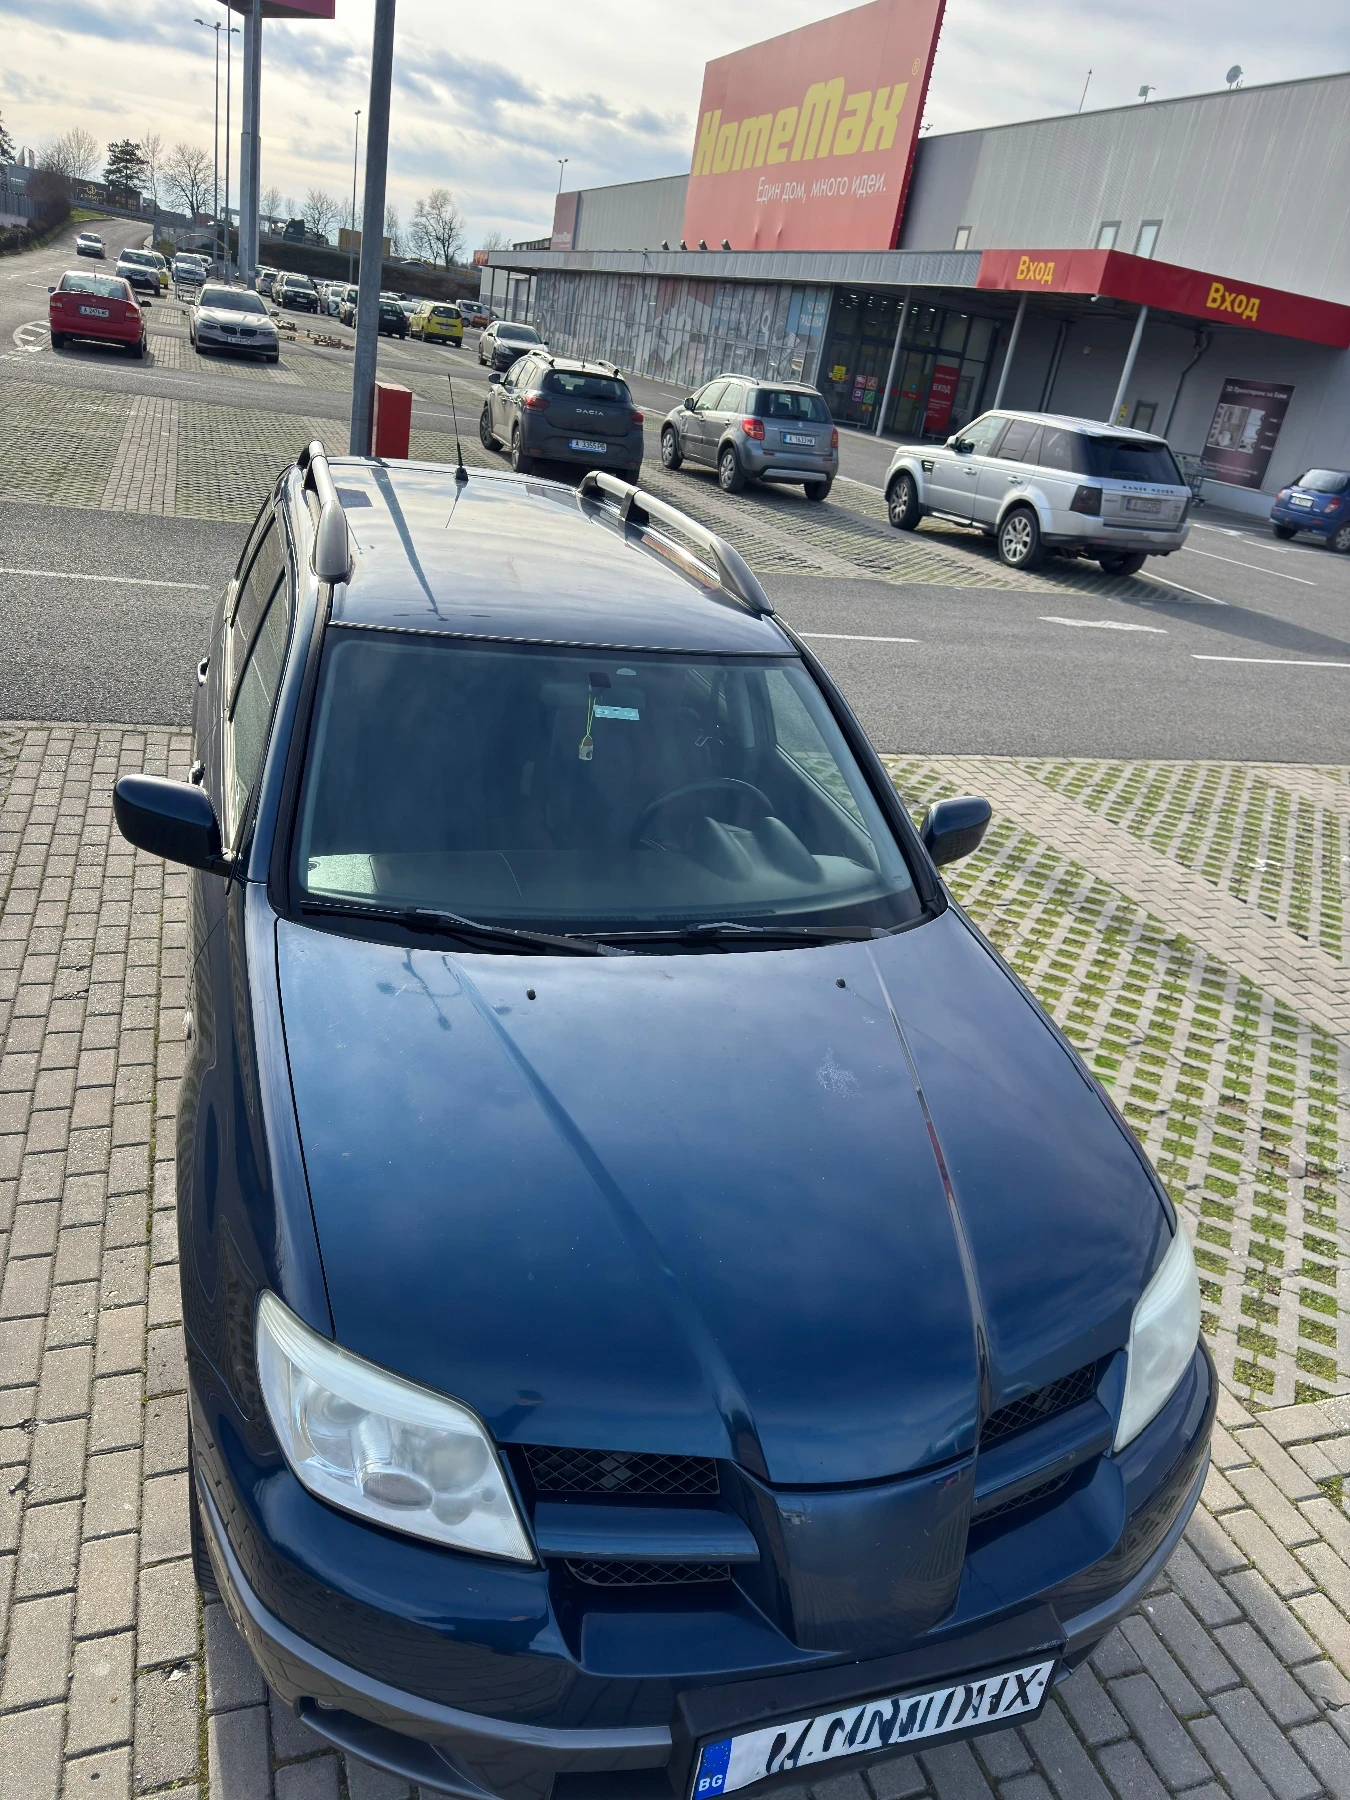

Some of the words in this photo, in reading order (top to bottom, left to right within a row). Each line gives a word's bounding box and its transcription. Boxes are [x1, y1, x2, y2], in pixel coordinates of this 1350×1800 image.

[693, 77, 908, 176] HomeMax
[756, 176, 782, 205] Един
[781, 181, 807, 204] дом,
[810, 176, 849, 198] много
[851, 171, 887, 198] идеи.
[1016, 255, 1055, 285] Вход
[1206, 281, 1261, 322] Вход
[576, 408, 603, 416] DACIA
[698, 1774, 724, 1792] BG
